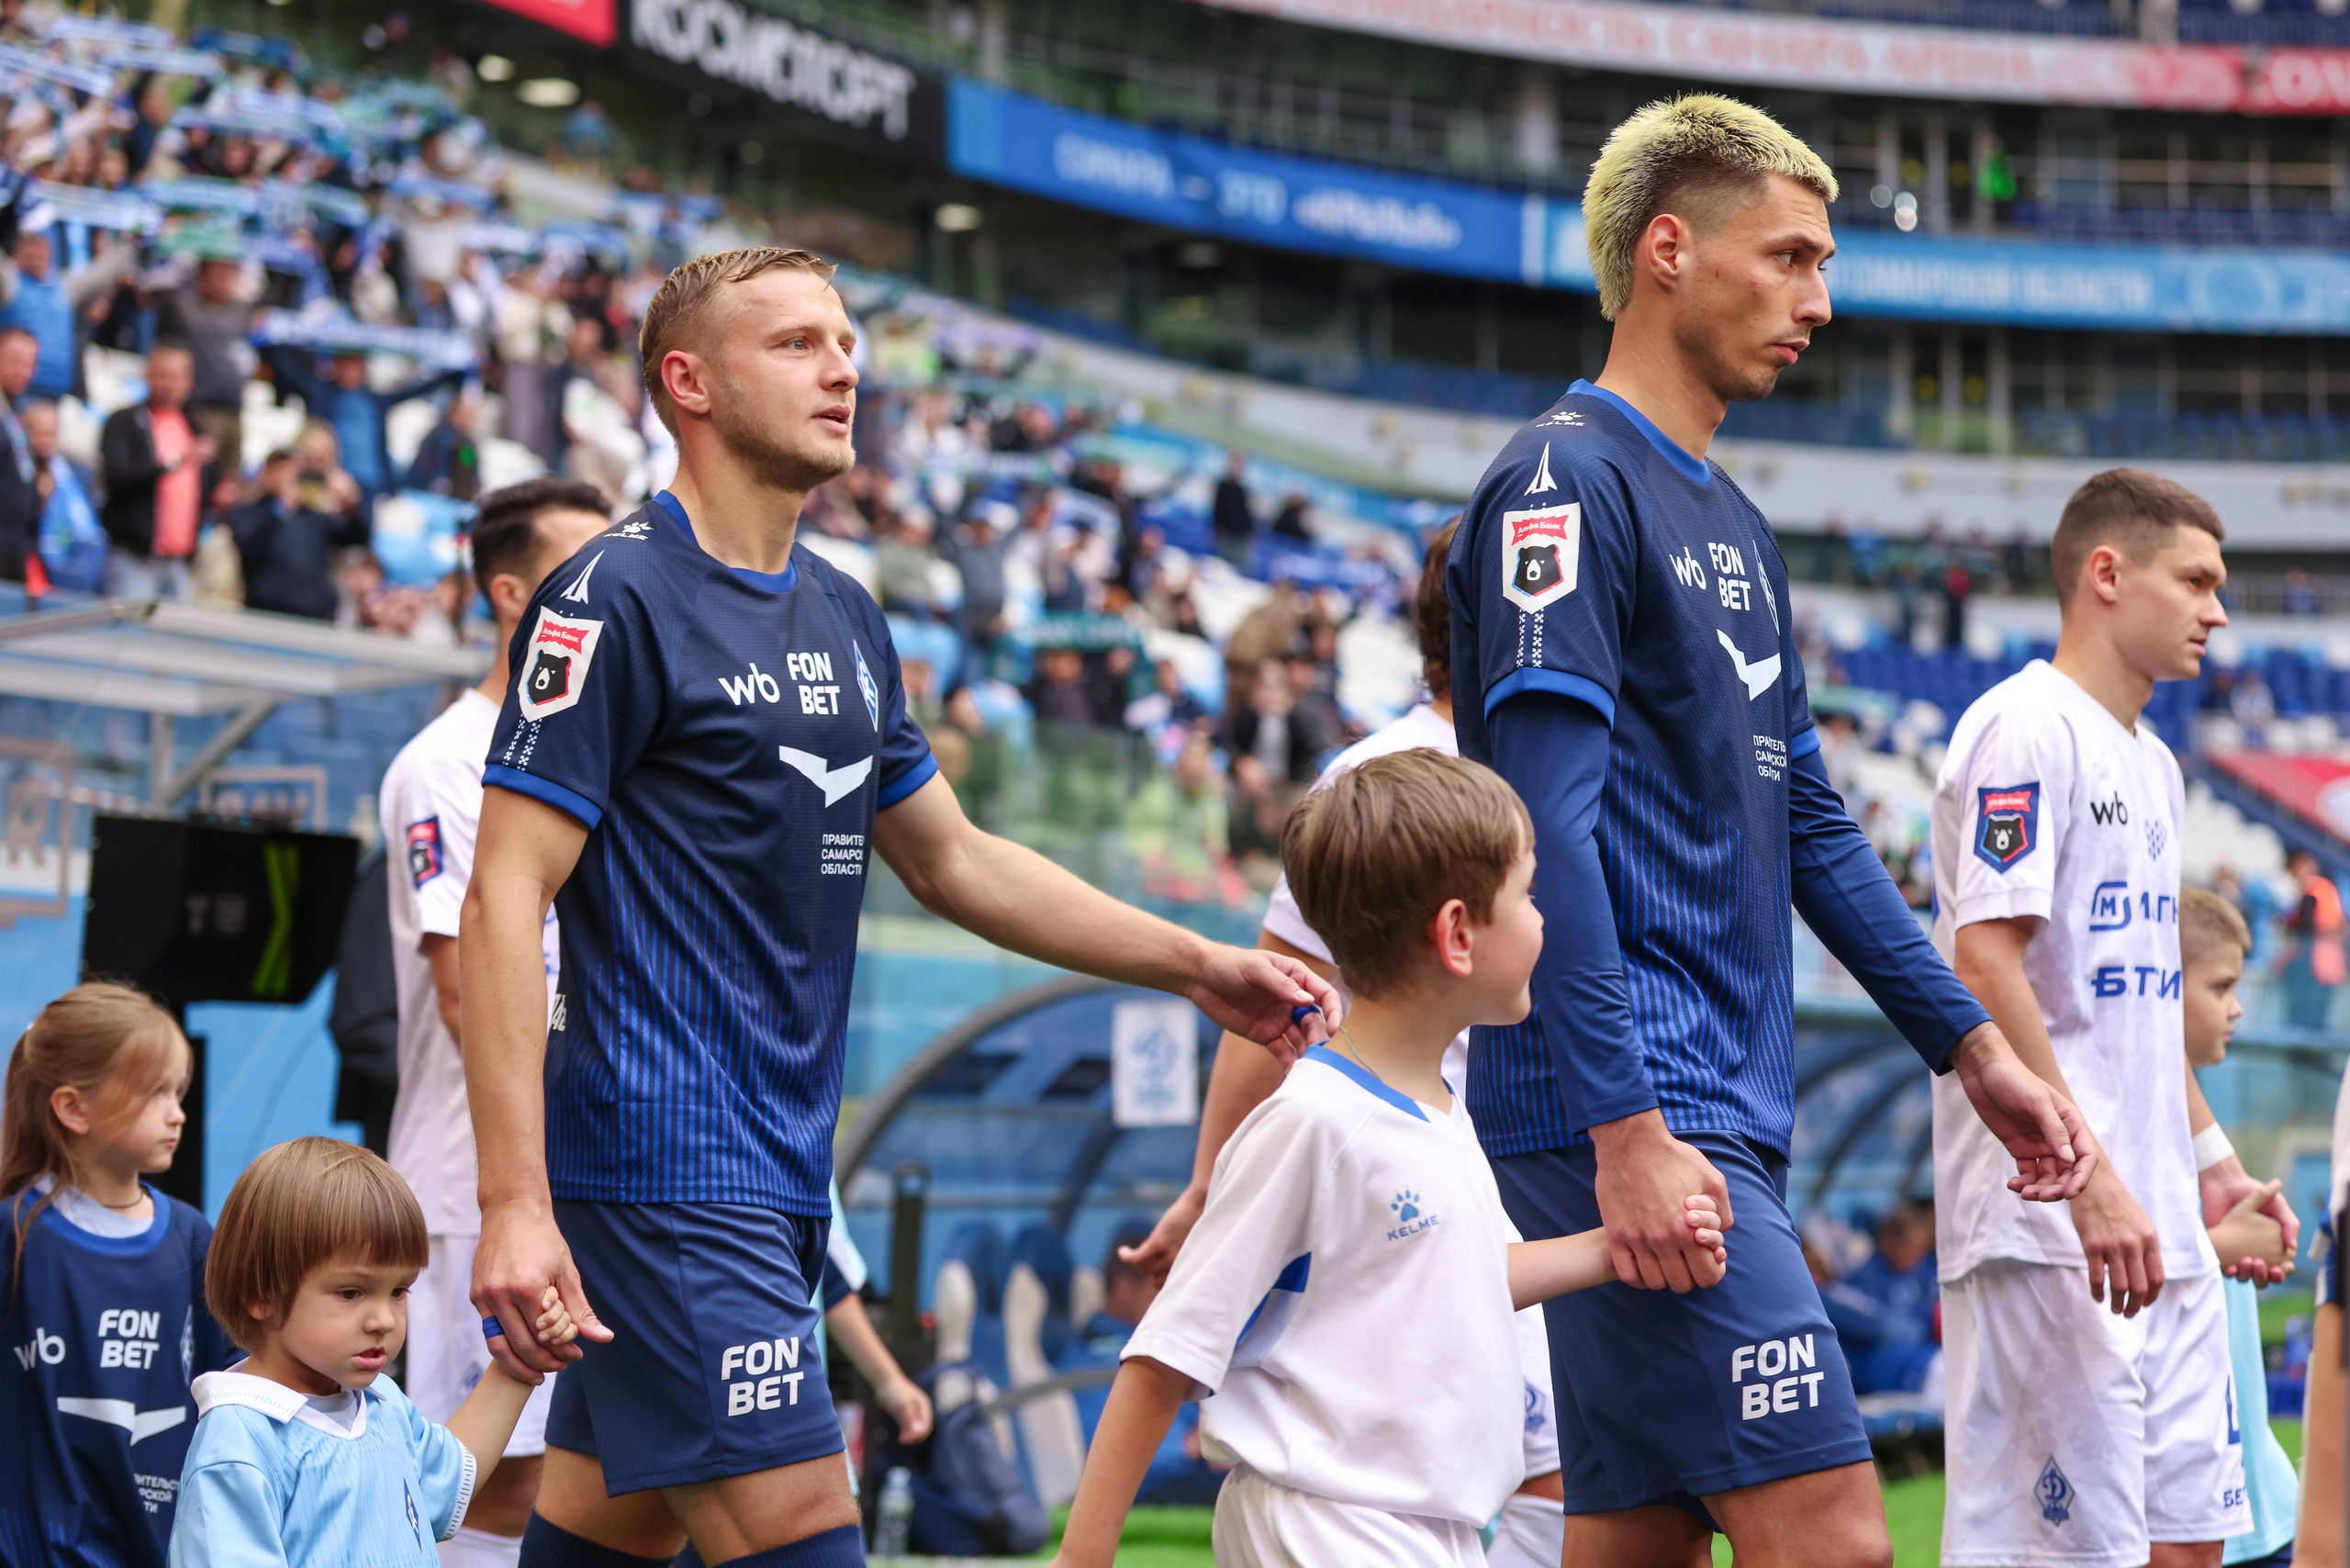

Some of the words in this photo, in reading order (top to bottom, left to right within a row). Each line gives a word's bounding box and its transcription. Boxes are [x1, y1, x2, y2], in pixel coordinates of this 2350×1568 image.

[1539, 521, 1561, 530] Банк
[1669, 546, 1707, 590] wb
[1708, 542, 1745, 576] FON
[1718, 576, 1751, 611] BET
[561, 631, 580, 643] Банк
[787, 652, 834, 682] FON
[718, 663, 780, 706] wb
[798, 685, 840, 715] BET
[2090, 790, 2128, 824] wb
[1387, 1215, 1438, 1241] KELME
[98, 1308, 160, 1339] FON
[14, 1327, 66, 1372] wb
[100, 1339, 160, 1370] BET
[721, 1336, 800, 1381] FON
[1731, 1333, 1816, 1383] FON
[728, 1371, 804, 1417] BET
[1741, 1371, 1825, 1421] BET
